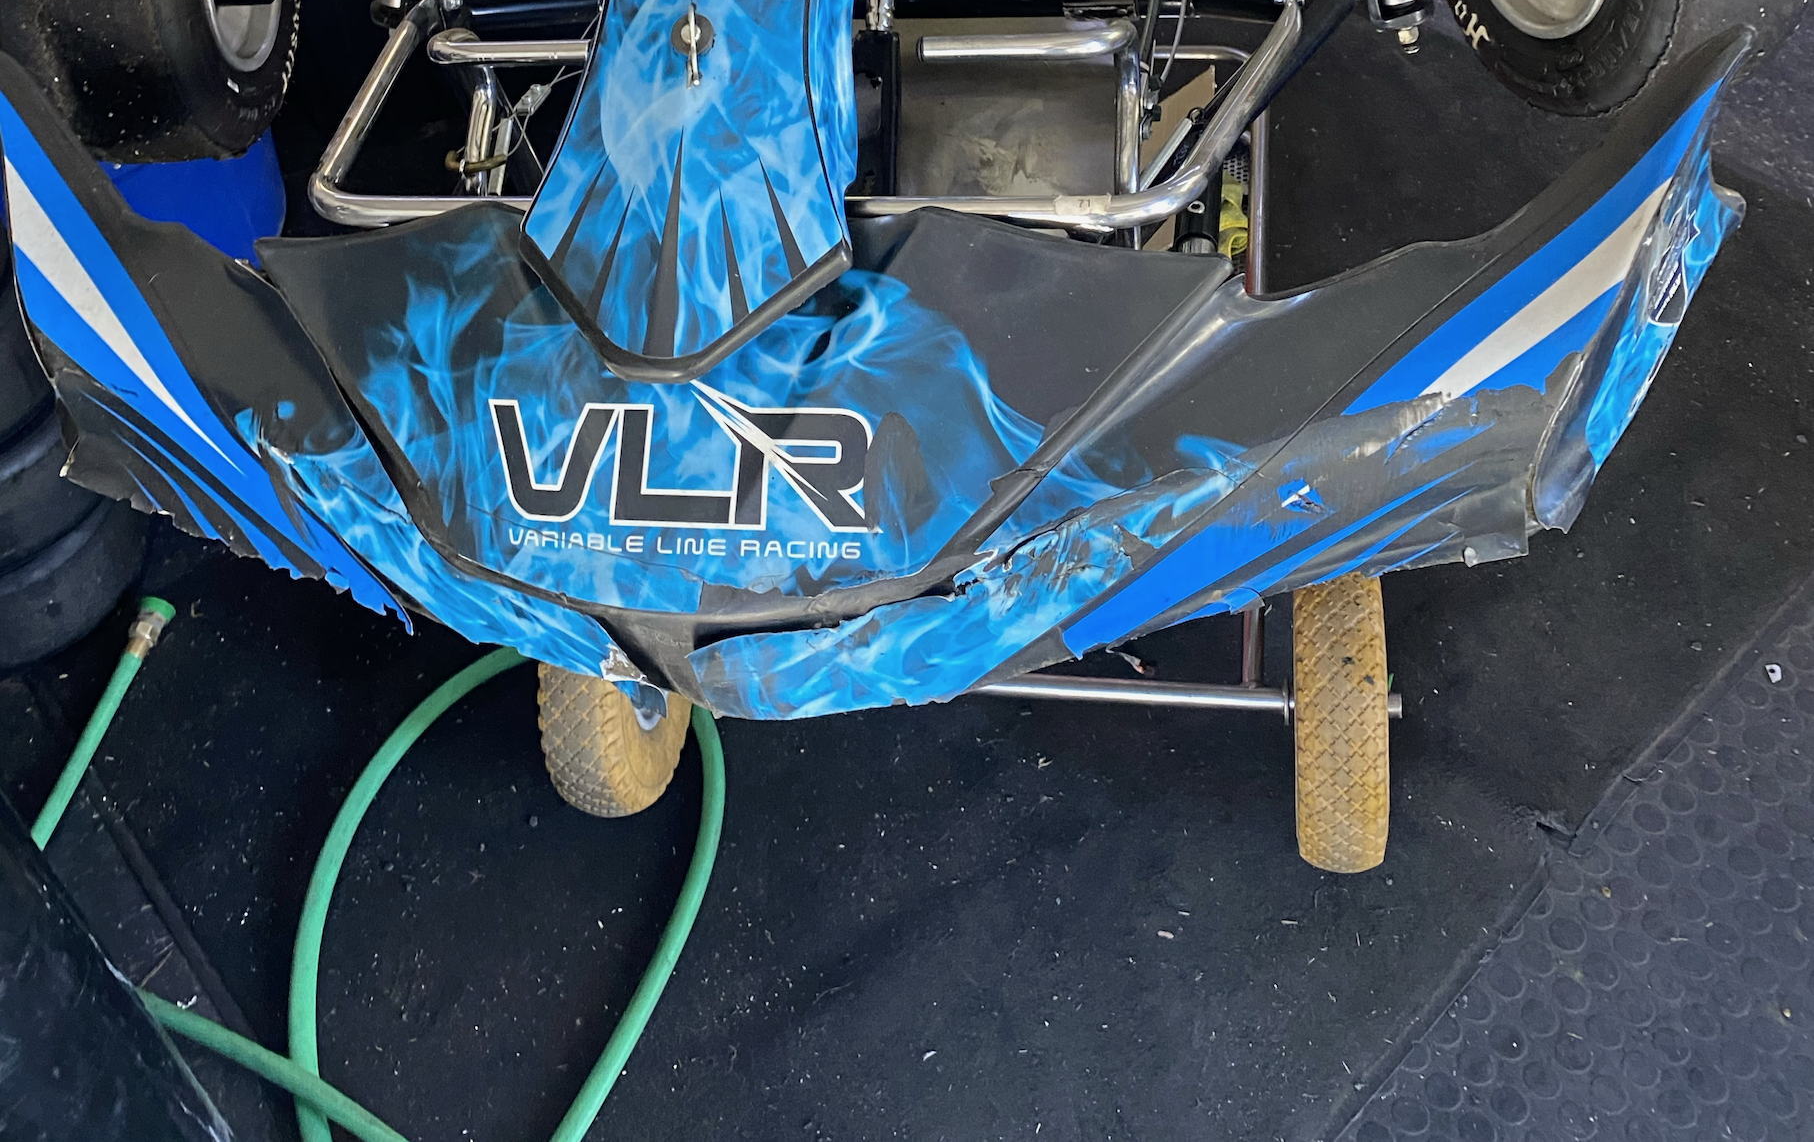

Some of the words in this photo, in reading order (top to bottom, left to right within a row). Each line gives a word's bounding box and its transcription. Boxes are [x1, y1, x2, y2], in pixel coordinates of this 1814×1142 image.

[1078, 199, 1091, 208] 71
[488, 379, 883, 533] VLR
[508, 528, 645, 553] VARIABLE
[656, 537, 727, 556] LINE
[740, 540, 862, 560] RACING
